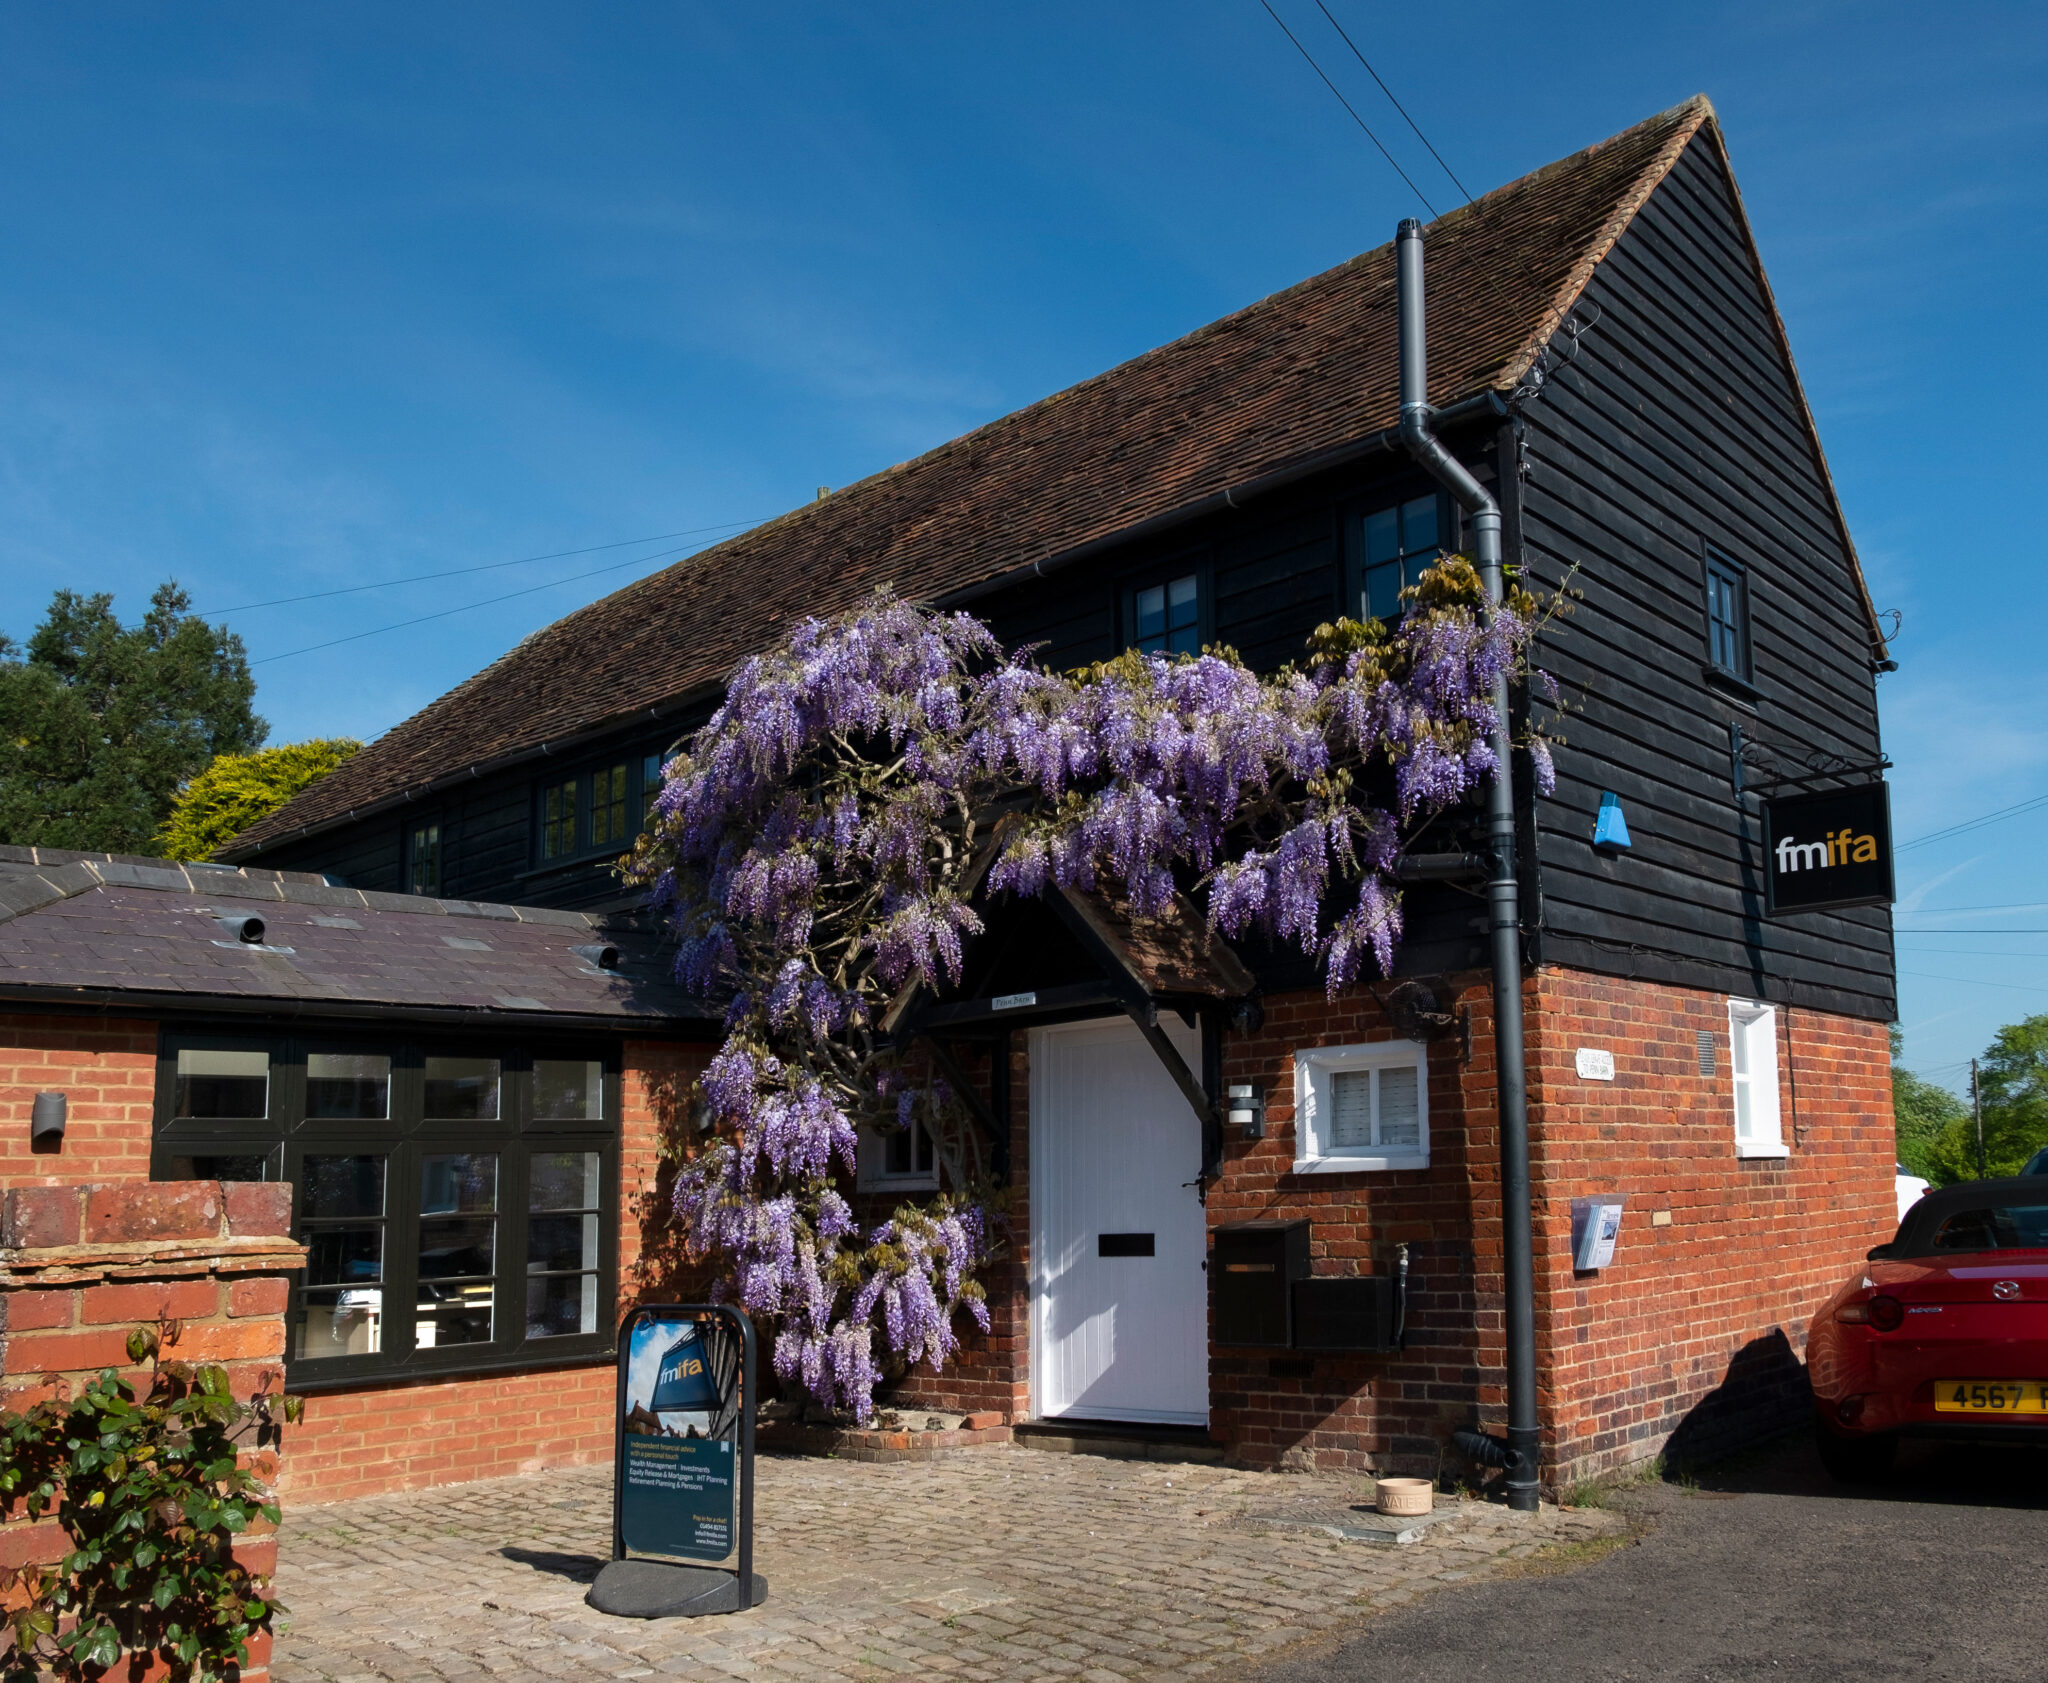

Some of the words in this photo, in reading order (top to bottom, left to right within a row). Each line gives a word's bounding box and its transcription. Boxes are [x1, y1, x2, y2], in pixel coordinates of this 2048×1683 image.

[1775, 828, 1877, 873] fmifa
[660, 1359, 703, 1385] fmifa
[1952, 1385, 2024, 1409] 4567
[630, 1441, 660, 1450] Independent
[680, 1445, 697, 1453] advice
[629, 1459, 646, 1467] Wealth
[646, 1461, 677, 1470] Management
[680, 1464, 711, 1473] Investments
[629, 1468, 645, 1477] Equity
[668, 1471, 694, 1481] Mortgages
[706, 1475, 728, 1486] Planning
[629, 1477, 656, 1485] Retirement
[655, 1479, 676, 1490] Planning
[681, 1482, 703, 1491] Pensions
[1381, 1494, 1427, 1508] WATER
